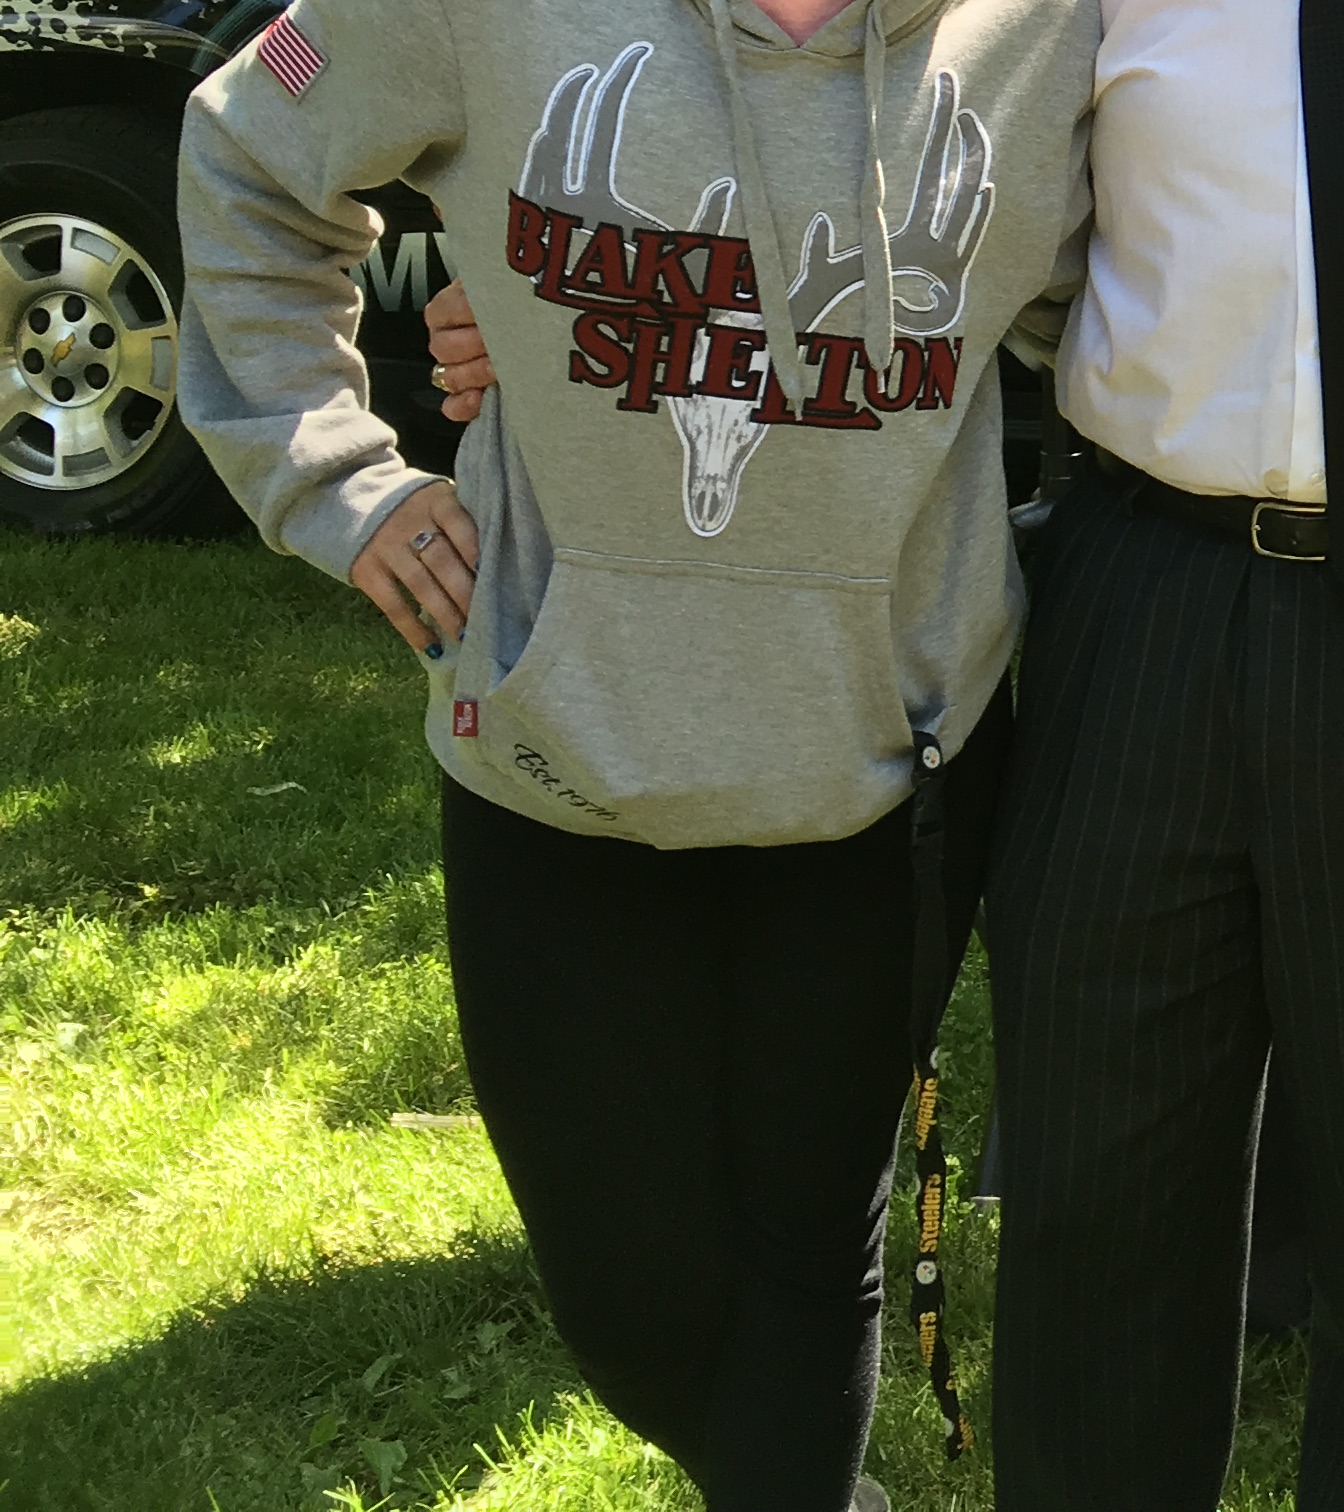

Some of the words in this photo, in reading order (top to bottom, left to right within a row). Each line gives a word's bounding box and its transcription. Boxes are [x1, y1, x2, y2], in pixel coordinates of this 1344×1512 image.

[507, 189, 762, 319] BLAKE
[568, 311, 965, 429] SHELTON
[919, 1173, 942, 1254] Steelers
